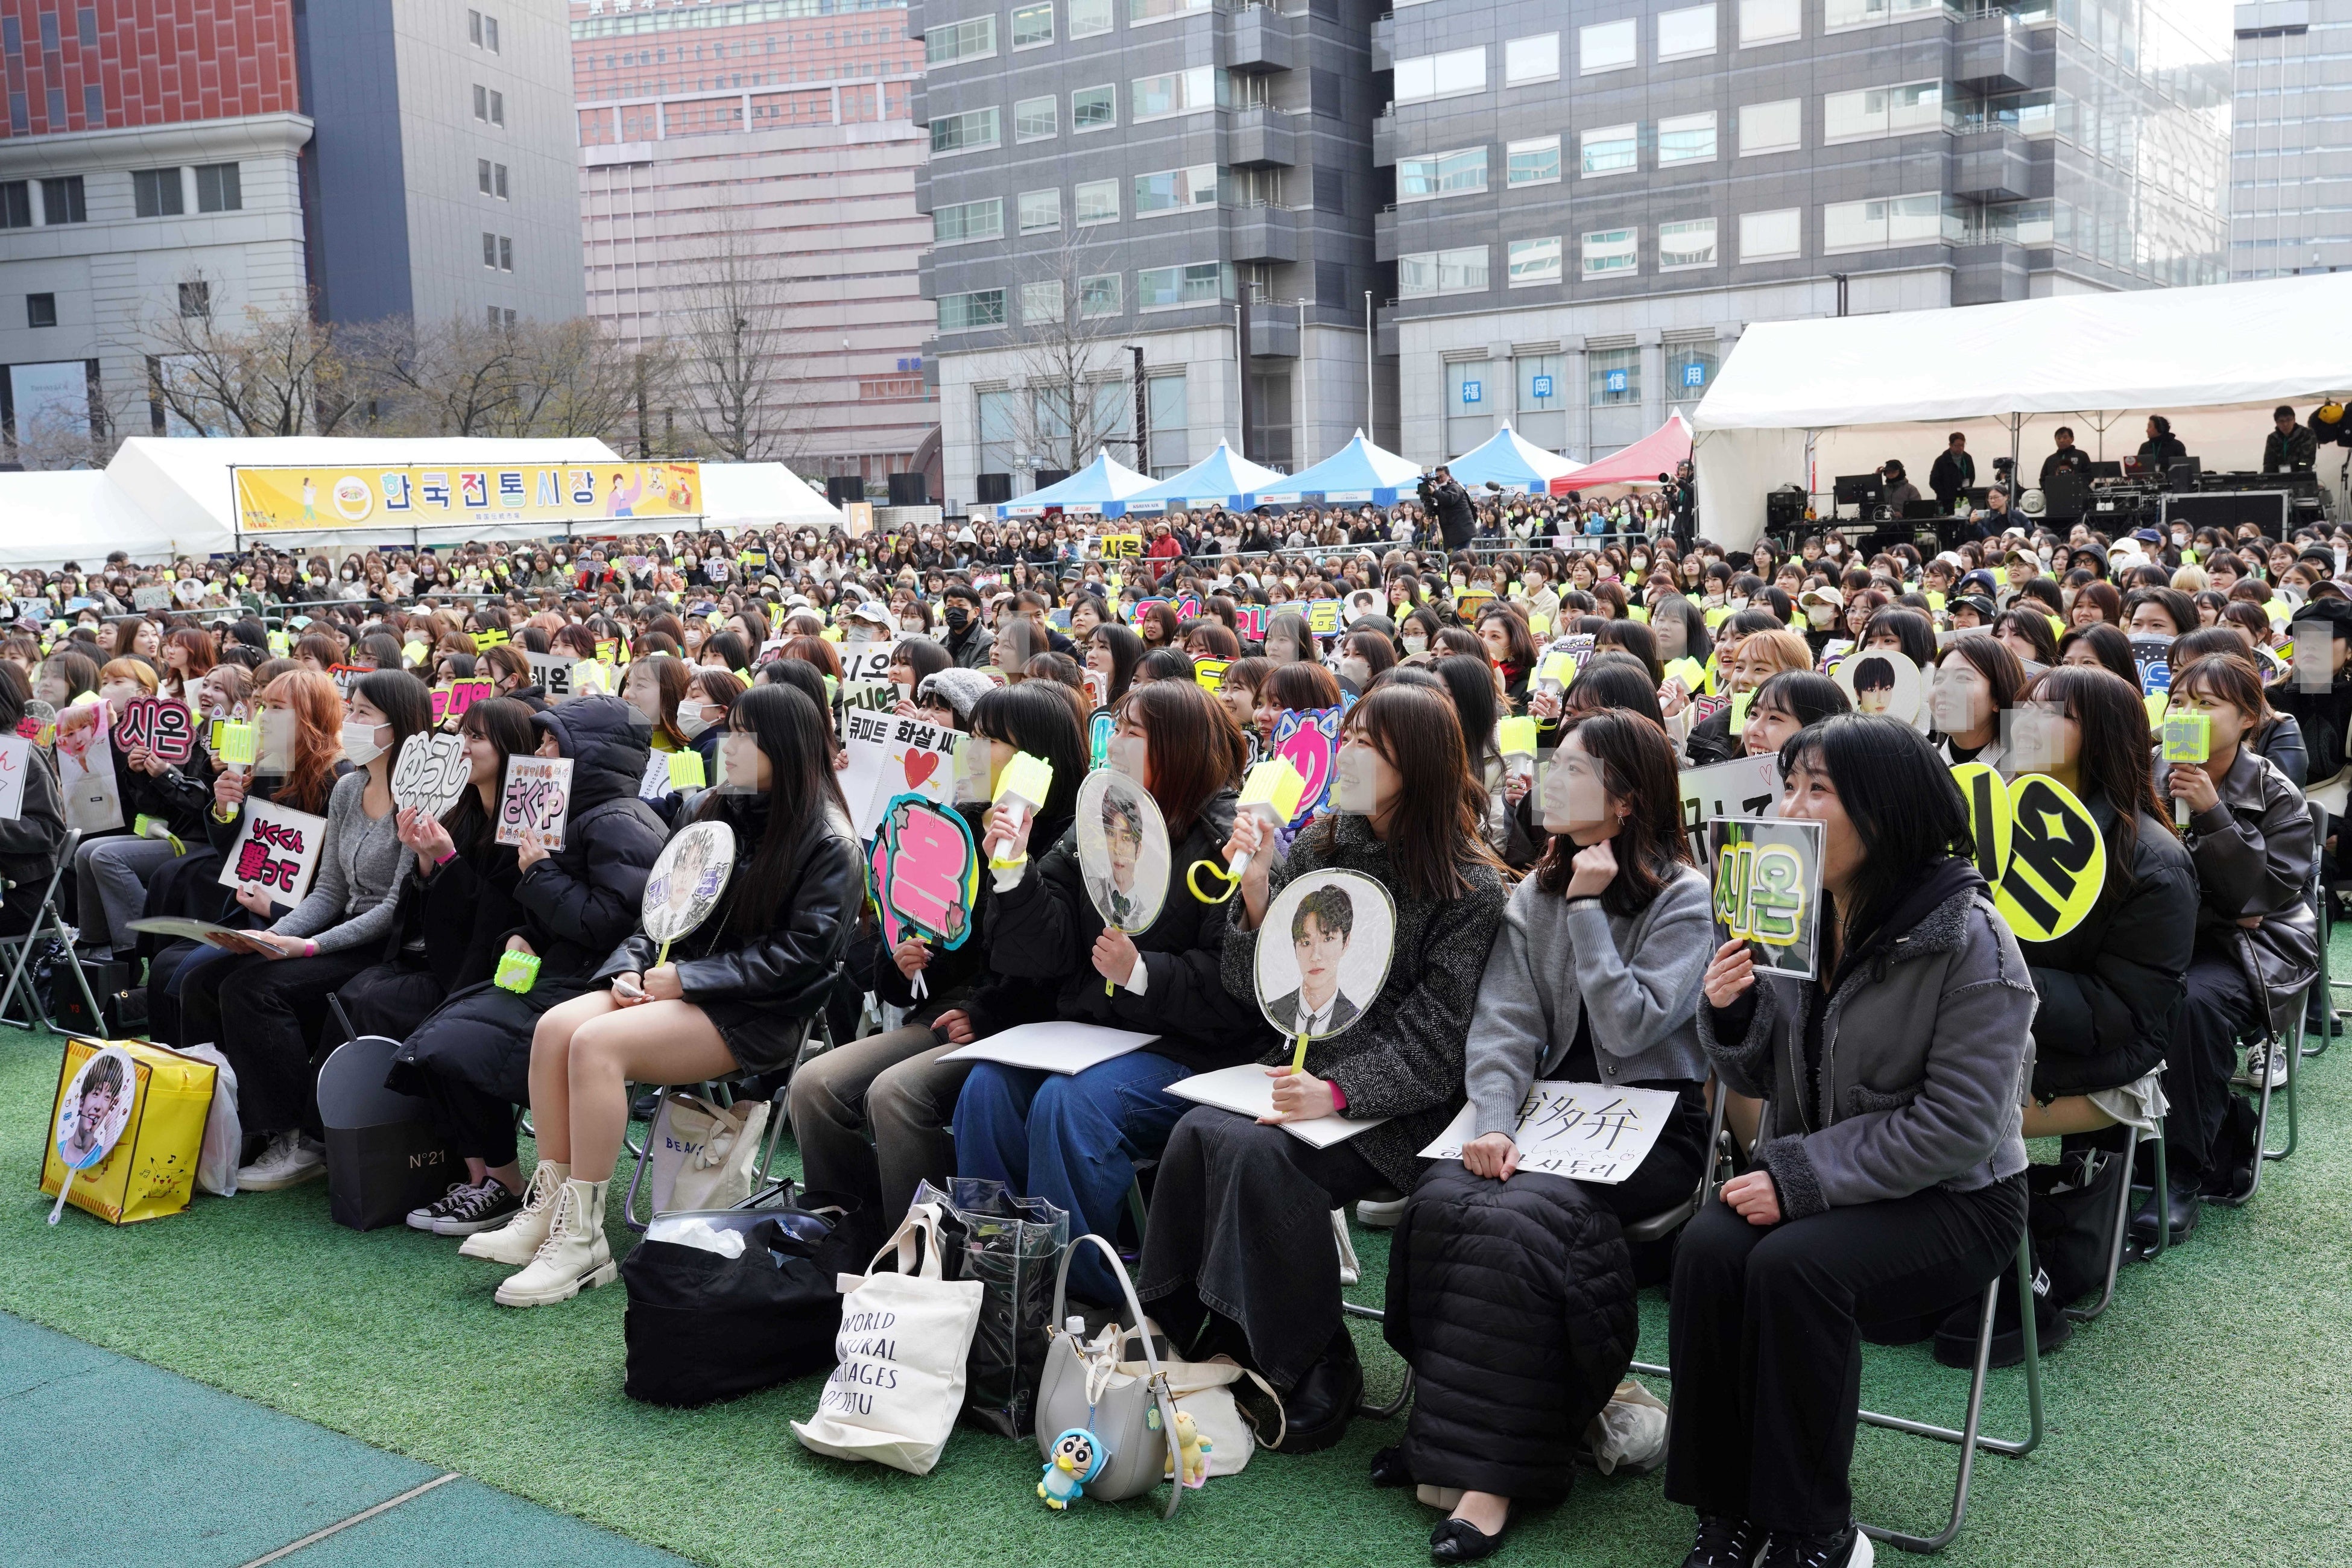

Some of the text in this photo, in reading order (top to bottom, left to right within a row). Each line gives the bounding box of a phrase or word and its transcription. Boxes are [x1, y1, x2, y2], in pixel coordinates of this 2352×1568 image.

[124, 706, 187, 753] 시온
[849, 716, 888, 744] 큐피트
[894, 721, 936, 749] 화살
[395, 739, 468, 798] ゆうし
[504, 777, 565, 830] さくや
[253, 818, 305, 854] りくくん
[235, 838, 300, 893] 撃って
[1716, 851, 1800, 934] 시온
[1535, 1159, 1617, 1177] 사투리
[842, 1312, 896, 1333] WORLD
[838, 1338, 897, 1361] TURAL
[822, 1391, 873, 1415] OF JEJU
